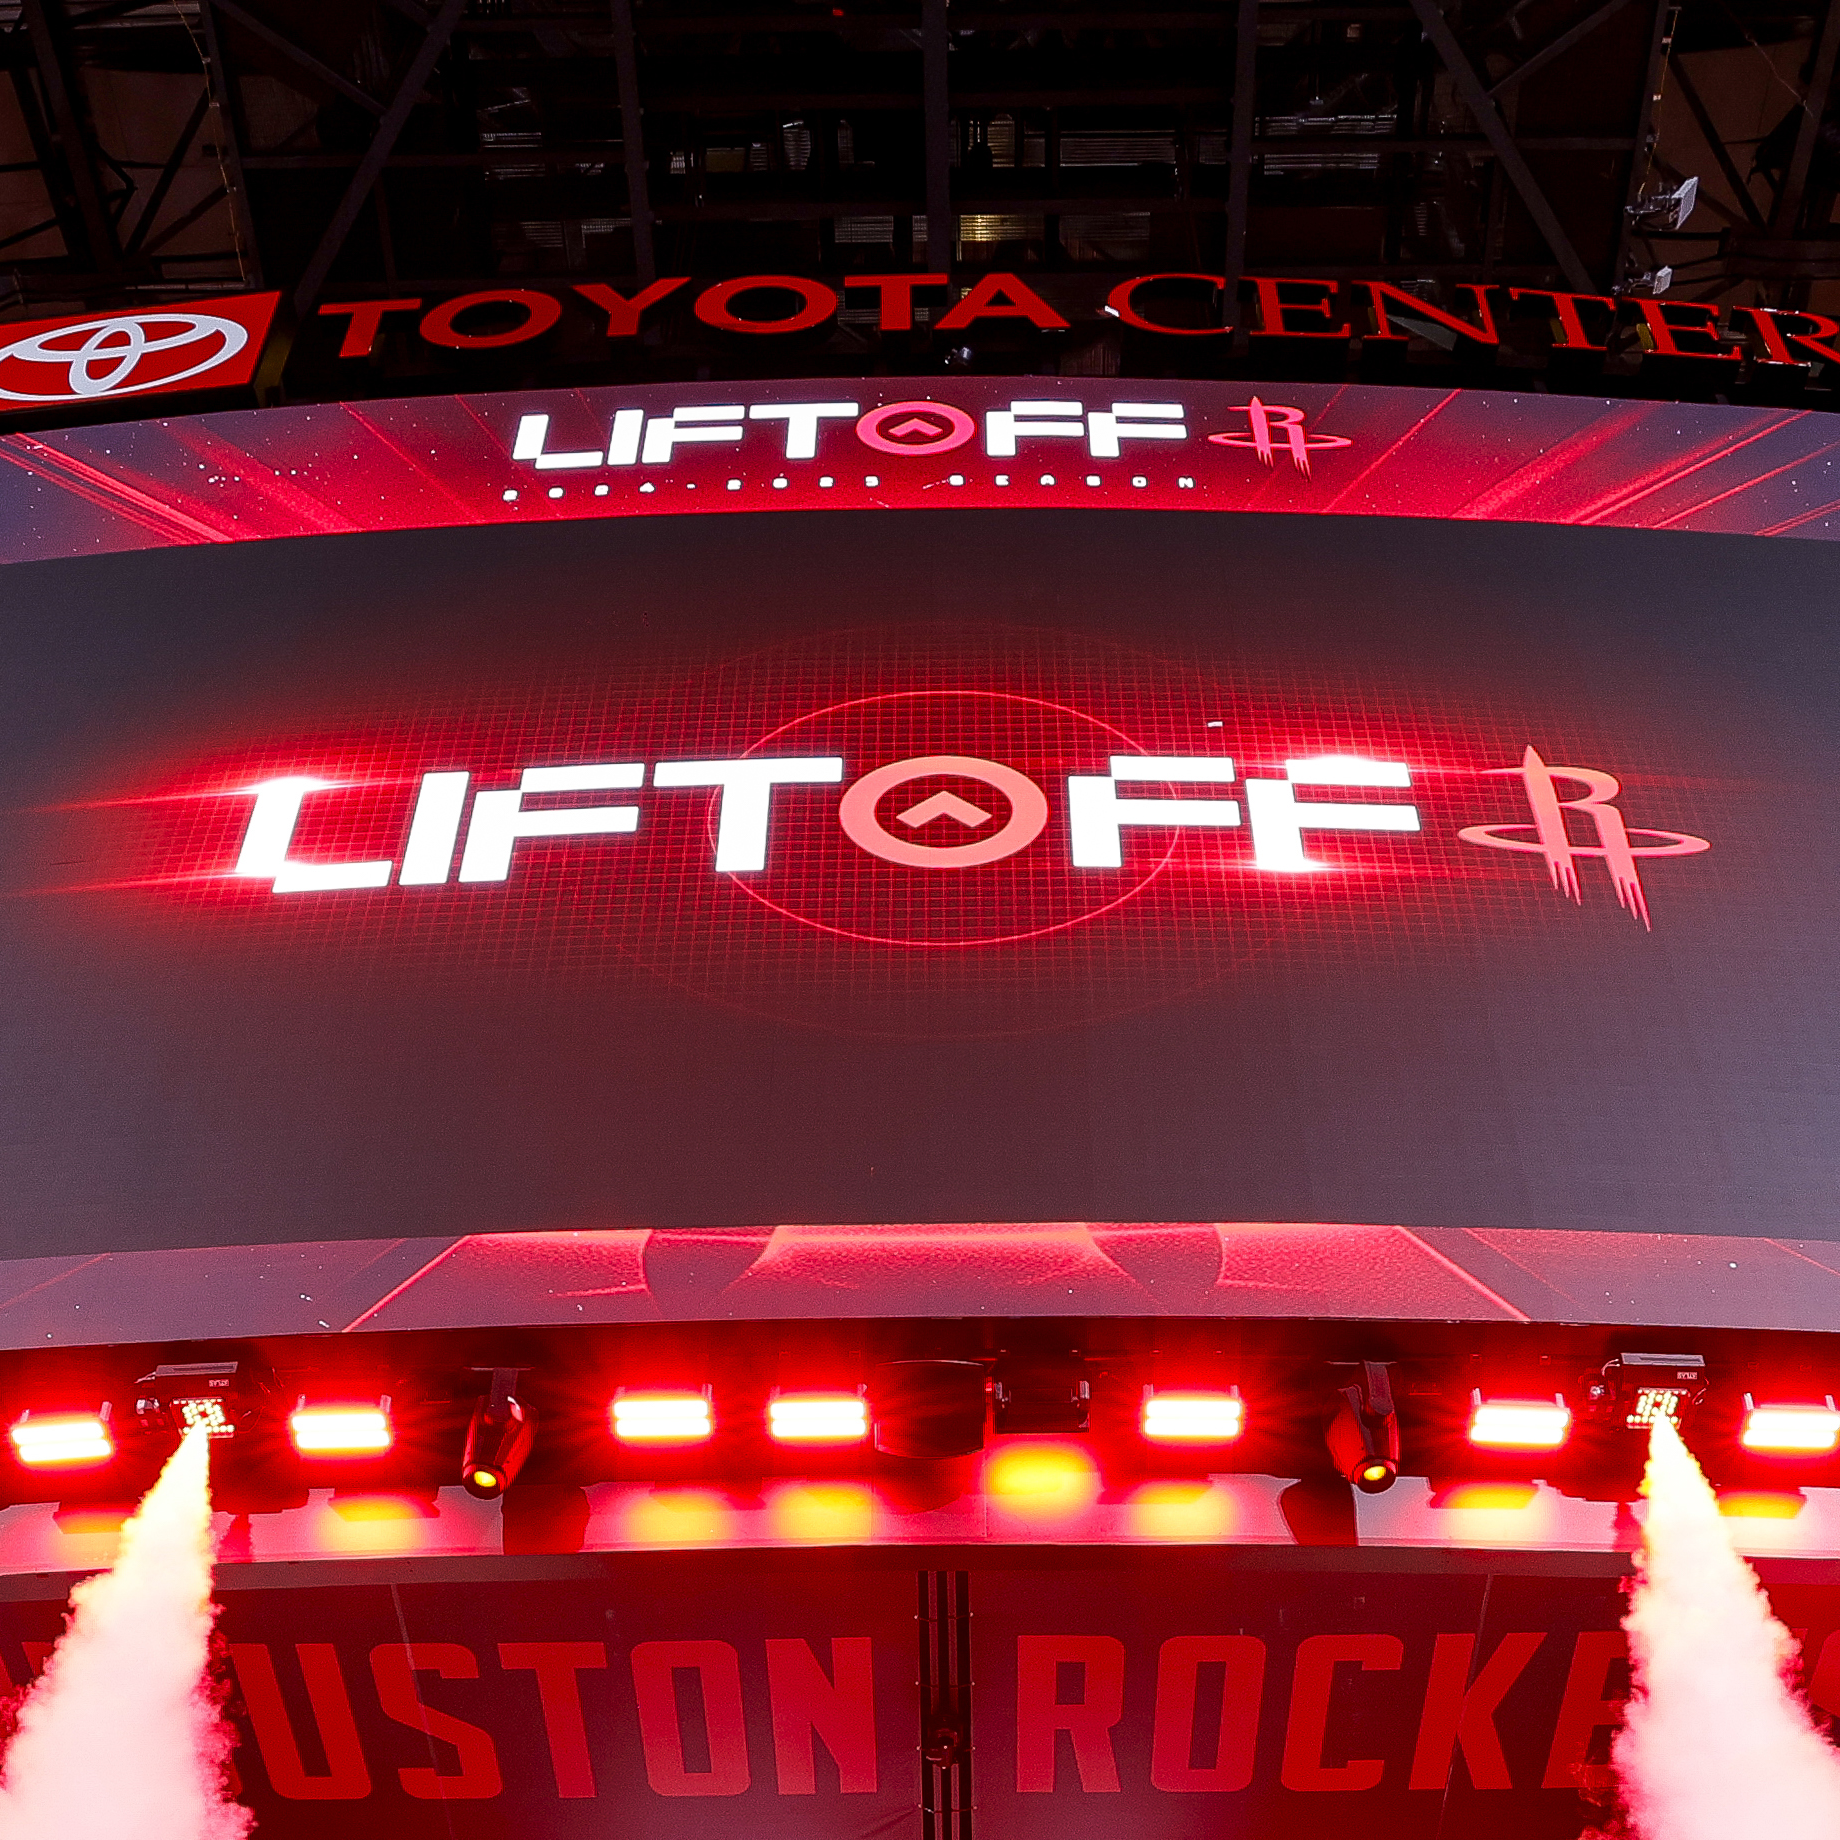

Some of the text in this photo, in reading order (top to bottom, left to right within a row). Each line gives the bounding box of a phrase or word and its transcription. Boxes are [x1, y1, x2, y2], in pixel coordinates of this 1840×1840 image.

[319, 272, 1070, 357] TOYOTA
[513, 400, 1187, 470] LIFTOFF
[233, 753, 1421, 895] LIFTOFF
